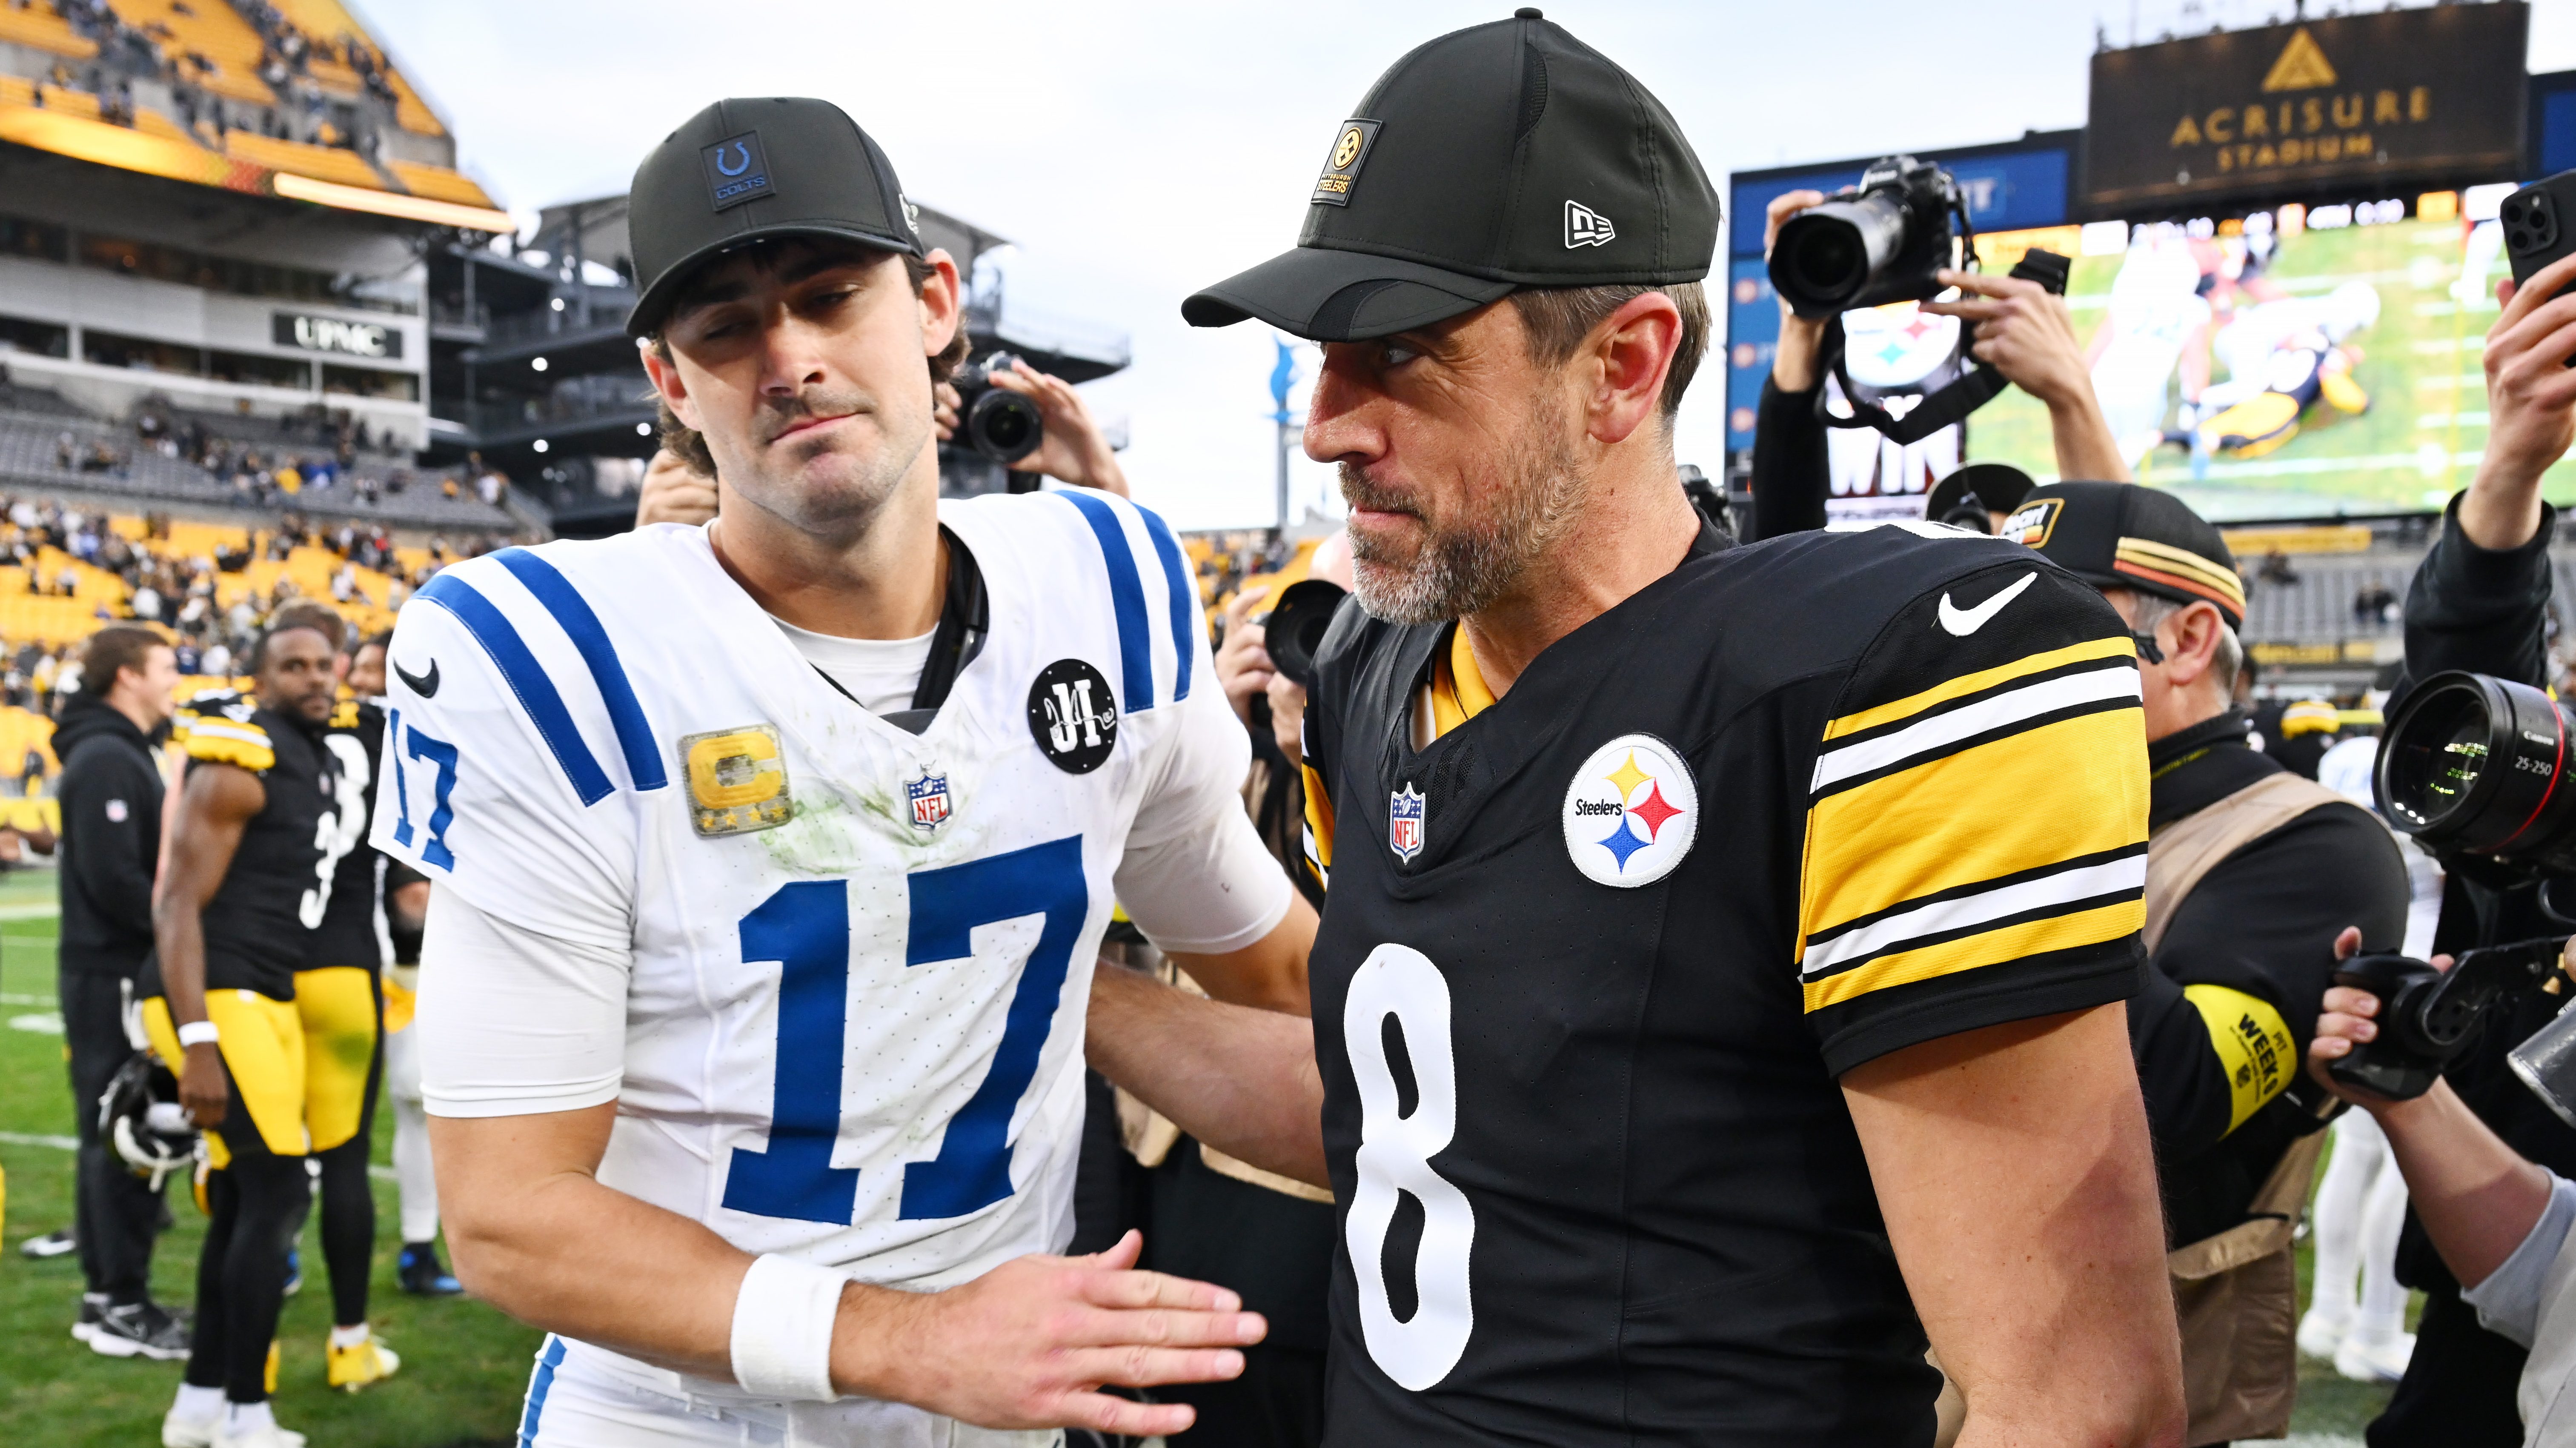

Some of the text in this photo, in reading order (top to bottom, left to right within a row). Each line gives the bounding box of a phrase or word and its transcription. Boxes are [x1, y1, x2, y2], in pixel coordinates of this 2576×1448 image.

[2170, 86, 2429, 147] ACRISURE
[2217, 132, 2373, 172] STADIUM
[717, 176, 765, 199] COLTS
[1317, 179, 1349, 193] STEELERS
[1321, 173, 1352, 182] PITTSBURGH
[294, 316, 386, 357] UPMC
[688, 731, 782, 809] C
[2515, 755, 2553, 776] 25-250
[390, 707, 458, 873] 17
[915, 796, 947, 822] NFL
[1575, 798, 1623, 816] Steelers
[1394, 820, 1417, 849] NFL
[721, 833, 1088, 1226] 17
[2239, 1013, 2278, 1082] WEEK
[1343, 942, 1475, 1391] 8
